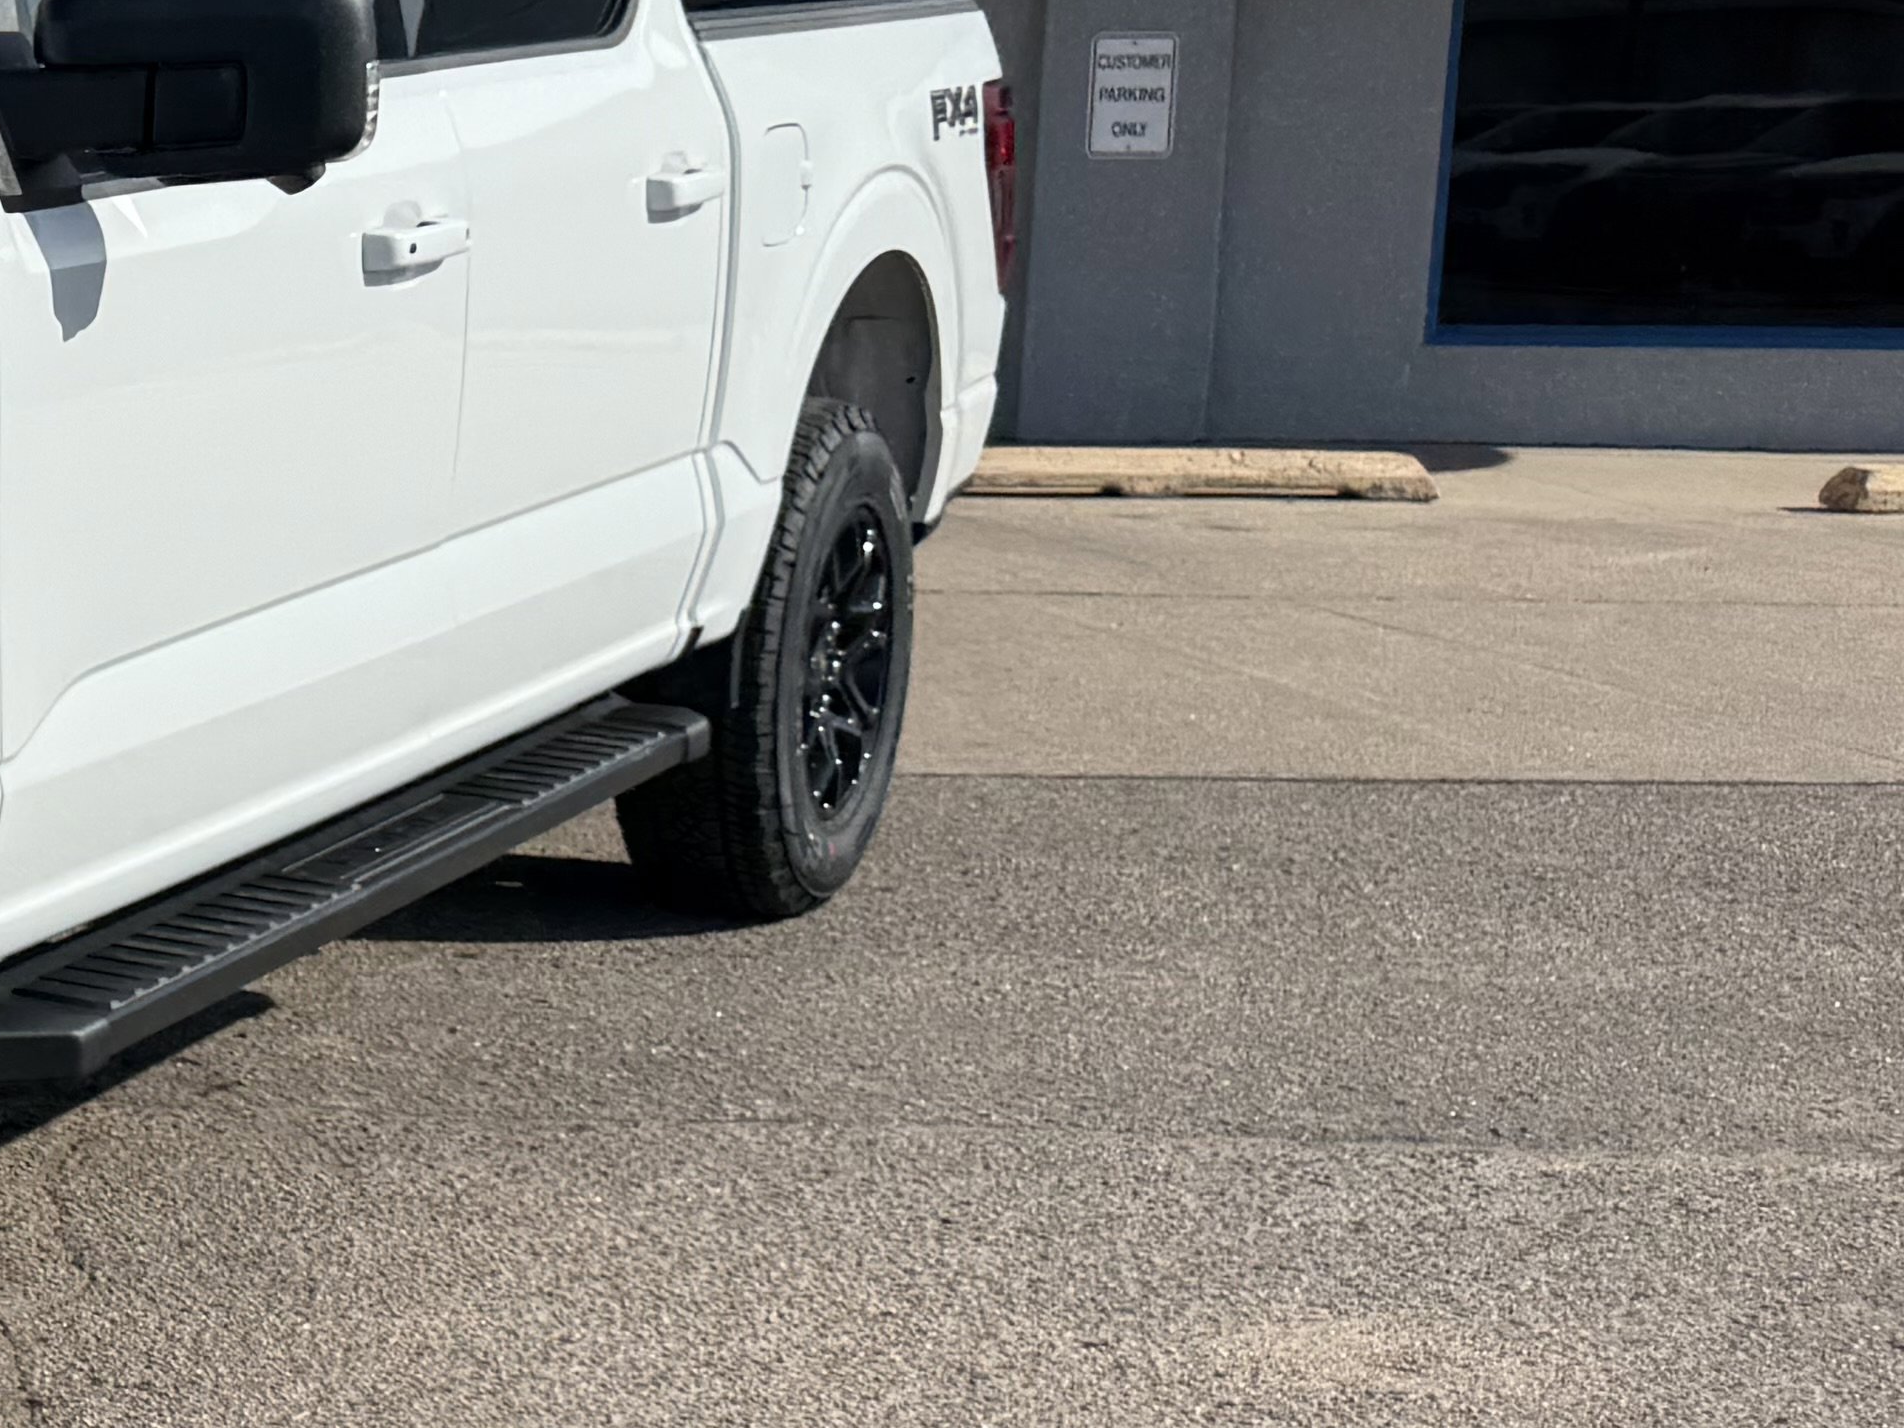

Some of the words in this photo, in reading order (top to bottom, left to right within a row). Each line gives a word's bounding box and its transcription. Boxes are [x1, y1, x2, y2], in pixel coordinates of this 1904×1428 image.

[1098, 54, 1171, 70] CUSTOMER
[1099, 86, 1165, 103] PARKING
[1111, 120, 1147, 138] ONLY
